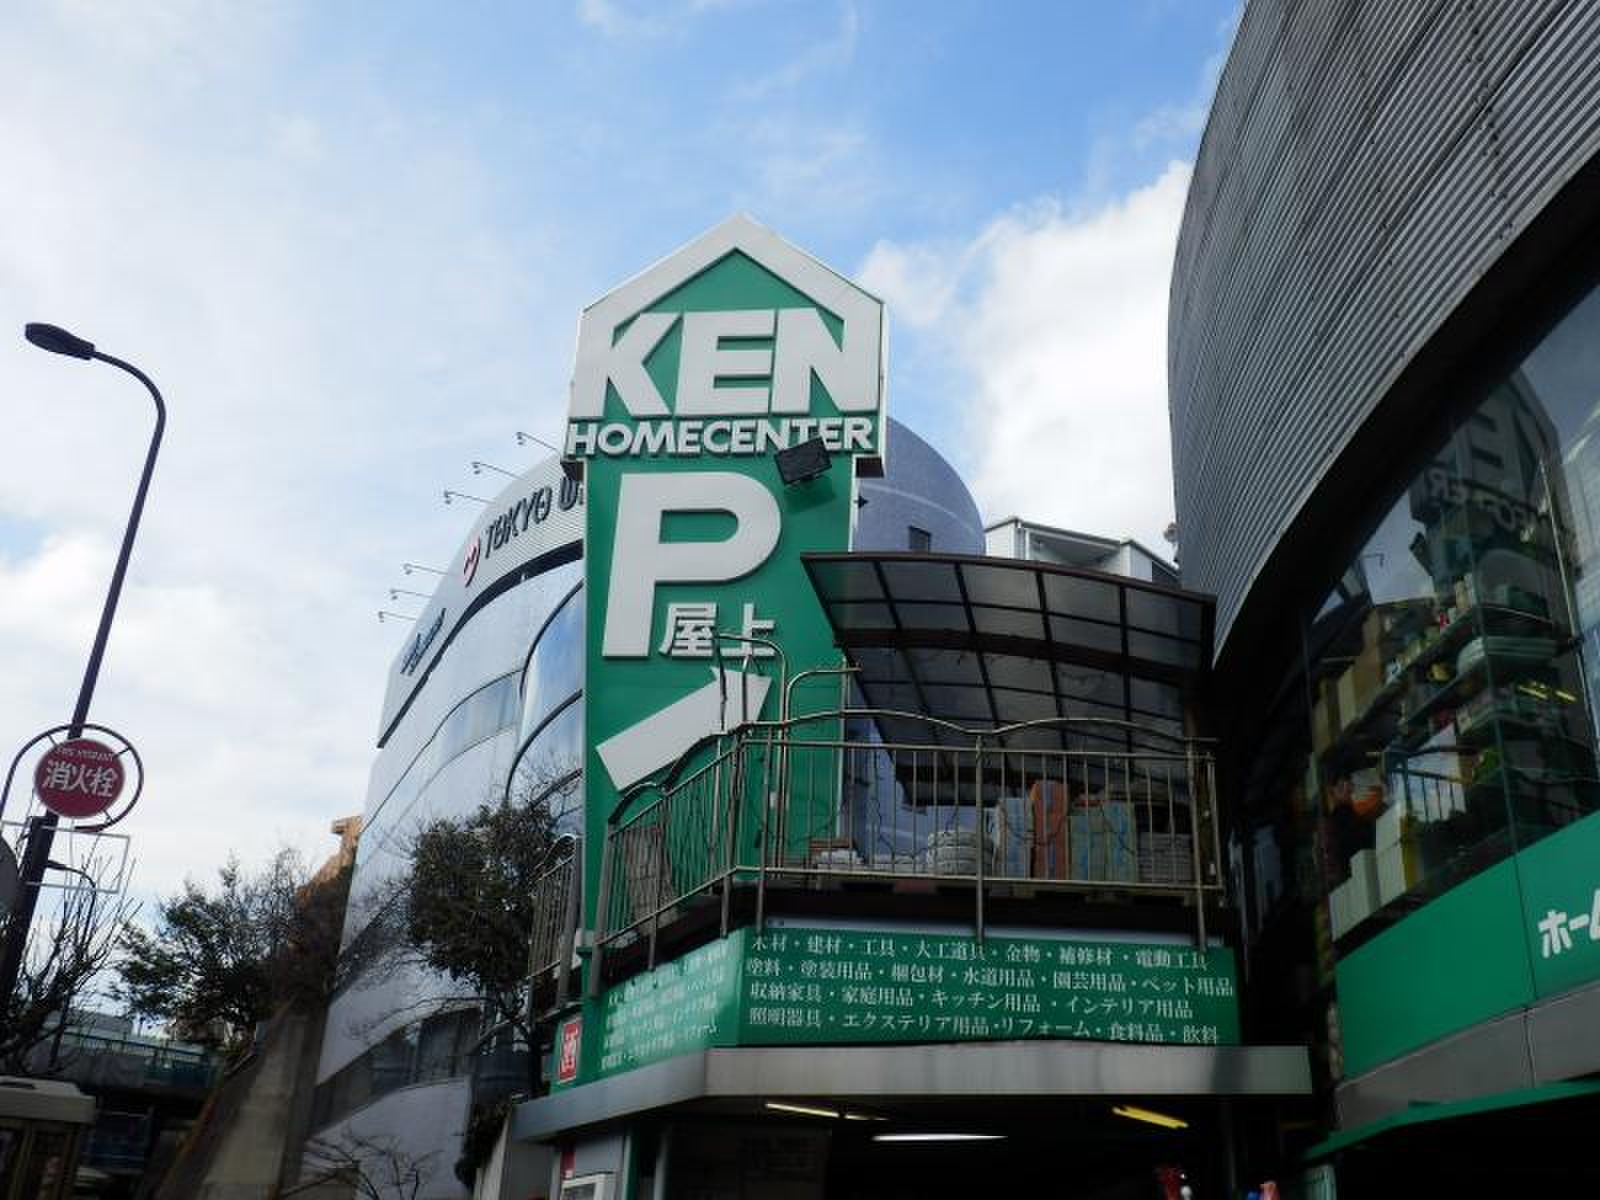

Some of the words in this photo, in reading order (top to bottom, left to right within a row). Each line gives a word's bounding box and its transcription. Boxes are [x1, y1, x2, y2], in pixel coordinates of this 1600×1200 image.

[568, 303, 882, 416] KEN
[567, 417, 874, 456] HOMECENTER
[484, 486, 552, 560] TOKYO
[602, 472, 782, 657] P
[659, 603, 775, 657] 屋上
[42, 759, 118, 797] 消火栓
